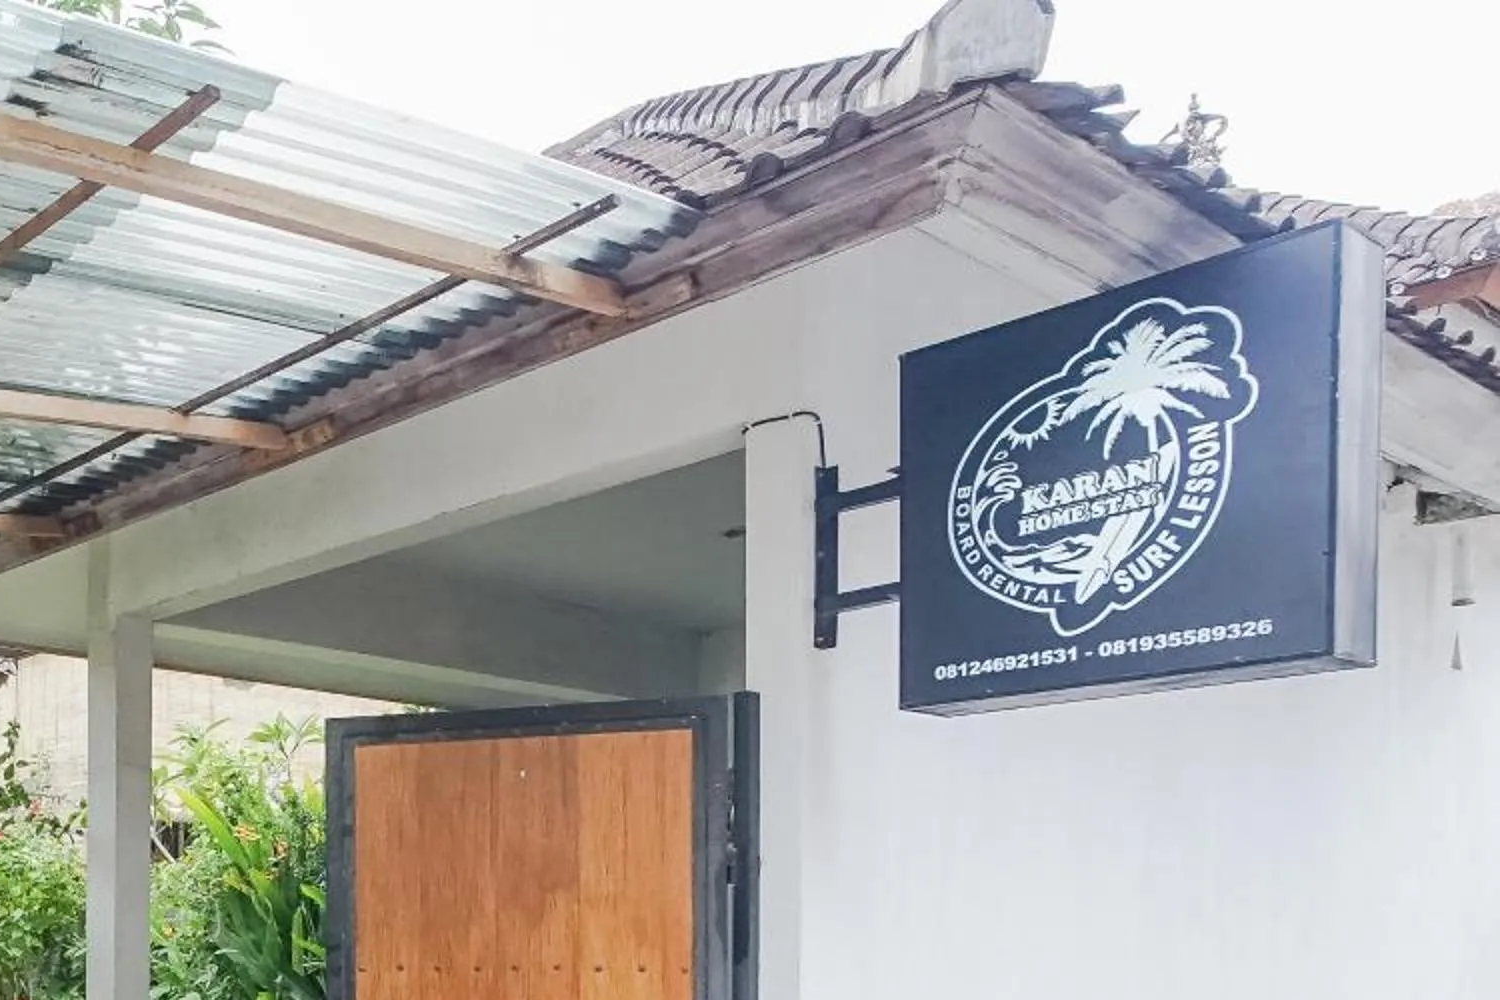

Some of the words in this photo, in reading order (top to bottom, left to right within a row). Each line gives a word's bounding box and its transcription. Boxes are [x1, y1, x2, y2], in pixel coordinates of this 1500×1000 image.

[1021, 454, 1159, 513] KARAN
[1113, 529, 1182, 594] SURF
[1170, 421, 1220, 529] LESSON
[955, 486, 982, 565] BOARD
[977, 563, 1066, 604] RENTAL
[934, 647, 1078, 681] 081246921531
[1098, 619, 1274, 657] 081935589326
